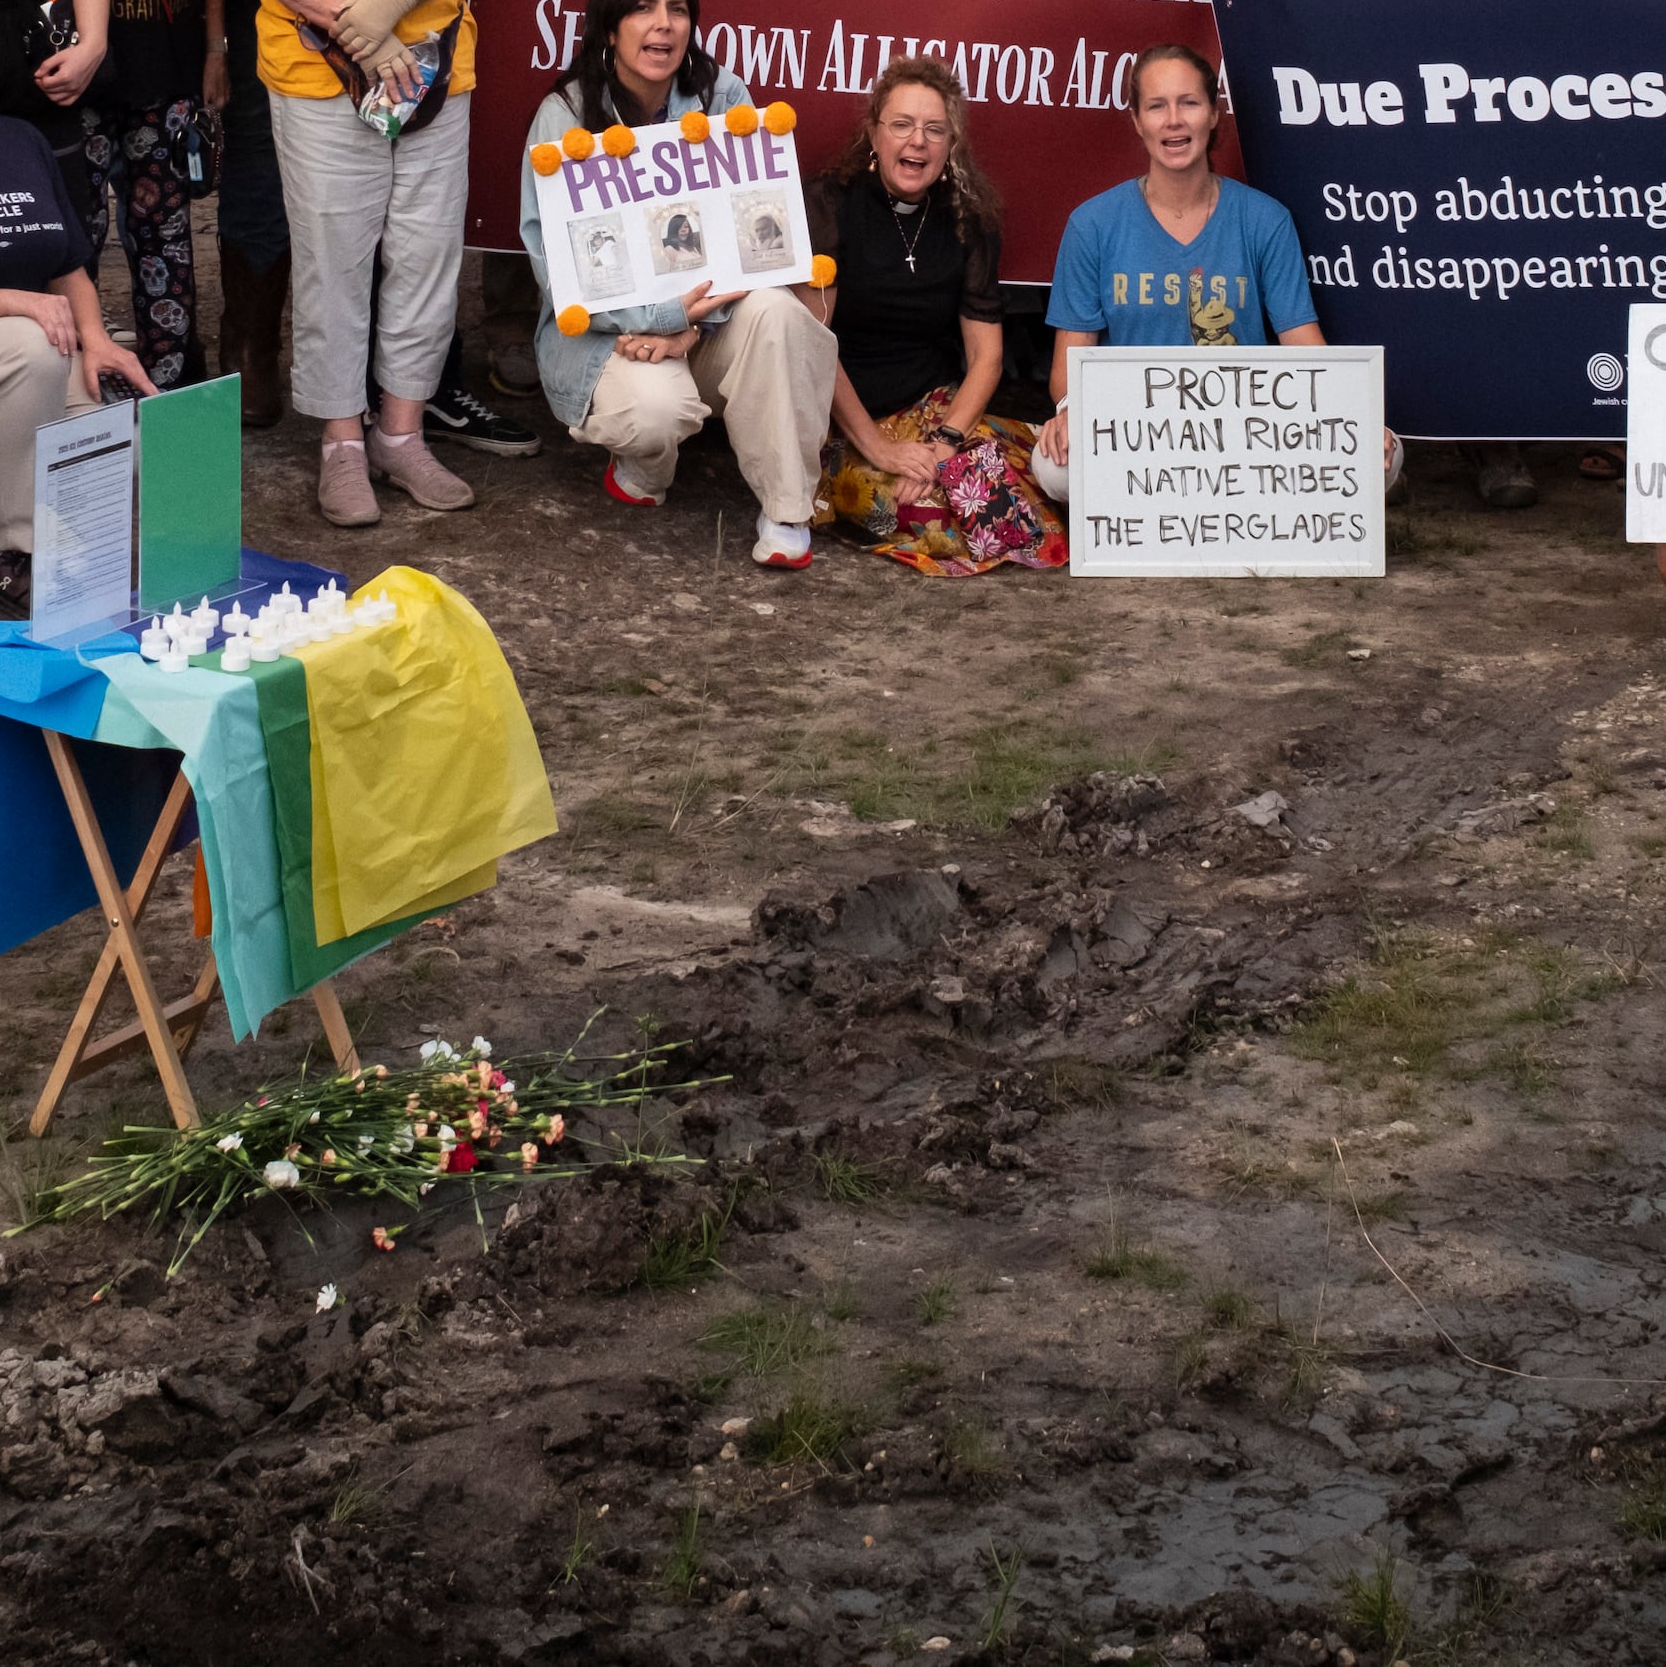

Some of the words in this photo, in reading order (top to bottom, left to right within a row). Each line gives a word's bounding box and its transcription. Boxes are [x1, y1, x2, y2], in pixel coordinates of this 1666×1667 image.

[1271, 65, 1407, 127] Due
[561, 126, 789, 214] PRESENTE
[0, 226, 13, 234] for
[22, 223, 41, 233] just
[1323, 181, 1419, 234] Stop
[1144, 366, 1327, 411] PROTECT
[1092, 418, 1224, 456] HUMAN
[1245, 417, 1359, 455] RIGHTS
[1127, 464, 1245, 498] NATIVE
[1249, 464, 1359, 498] TRIBES
[1086, 514, 1144, 548] THE
[1159, 512, 1367, 546] EVERGLADES
